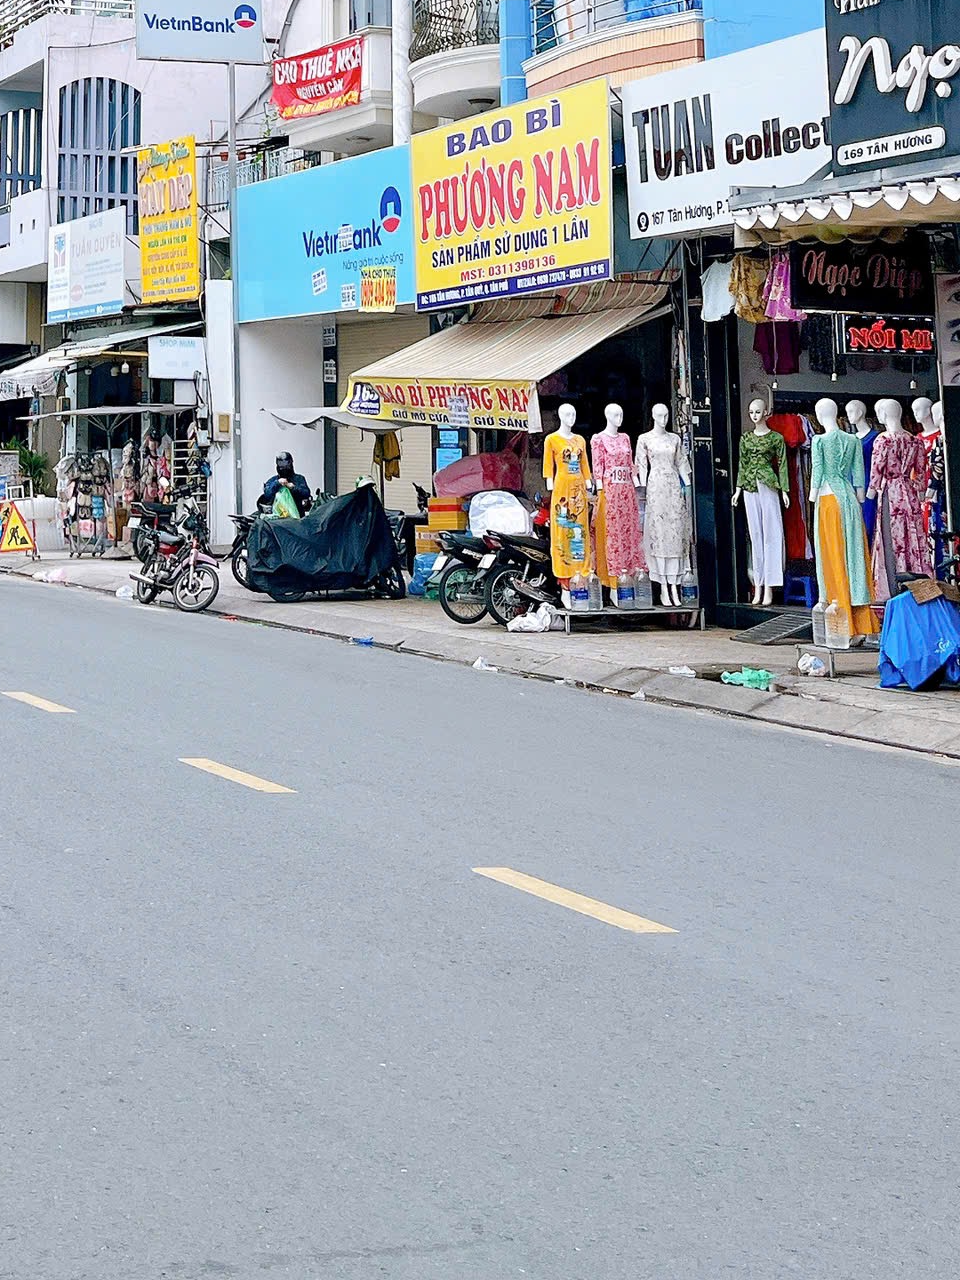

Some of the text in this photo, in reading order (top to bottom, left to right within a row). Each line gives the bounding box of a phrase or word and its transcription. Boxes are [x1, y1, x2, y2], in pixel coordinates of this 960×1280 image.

[143, 12, 236, 33] VietinBank
[274, 60, 298, 85] CHO
[301, 47, 334, 81] THUÊ
[446, 98, 562, 158] BAO BÌ
[631, 93, 716, 184] TUAN
[843, 133, 933, 161] 169 TÂN HƯƠNG
[418, 137, 602, 242] PHƯƠNG NAM
[651, 211, 665, 226] 167
[668, 207, 683, 223] Tân
[716, 200, 725, 215] P.
[431, 214, 589, 269] SẢN PHẨM SỬ DỤNG 1 LẦN
[460, 254, 557, 282] MST: 0311398136
[802, 249, 863, 297] Ngọc
[848, 320, 933, 350] NỐI MI
[407, 379, 426, 407] BÌ
